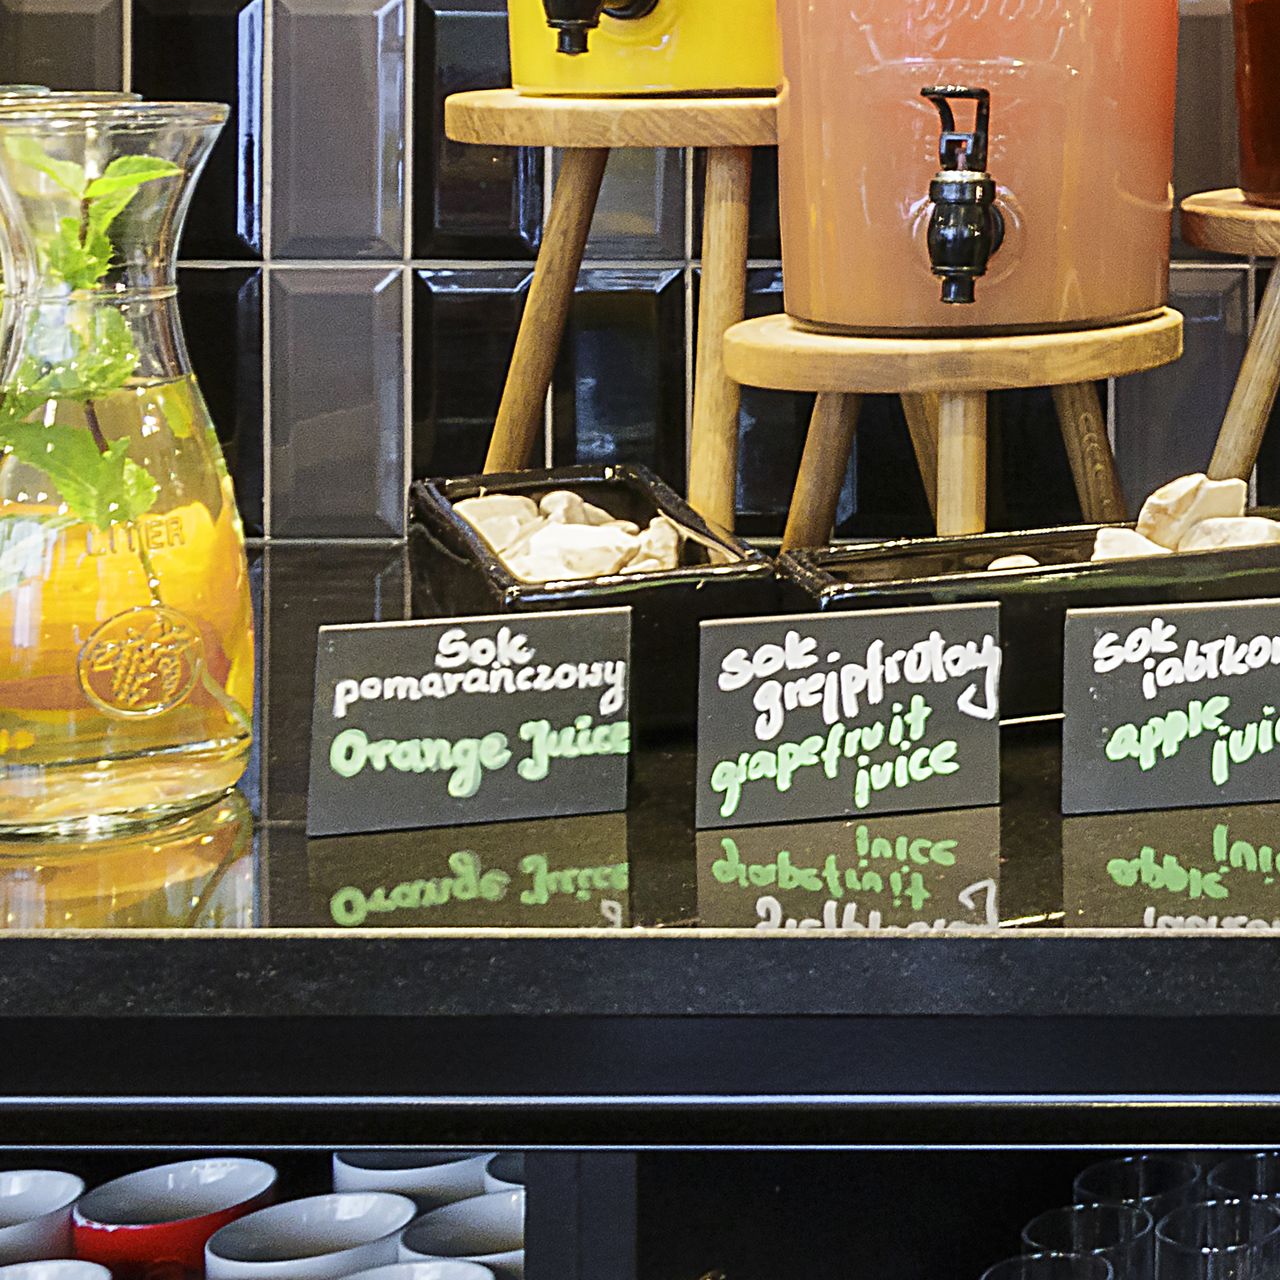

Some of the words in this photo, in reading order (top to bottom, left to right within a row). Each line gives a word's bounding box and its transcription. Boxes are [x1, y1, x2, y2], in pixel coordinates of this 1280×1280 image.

[332, 659, 626, 718] pomarańczowy
[330, 728, 512, 798] Orange
[518, 715, 630, 781] Juice
[710, 693, 932, 818] grapefruit
[1105, 696, 1230, 772] apple
[854, 740, 960, 809] juice
